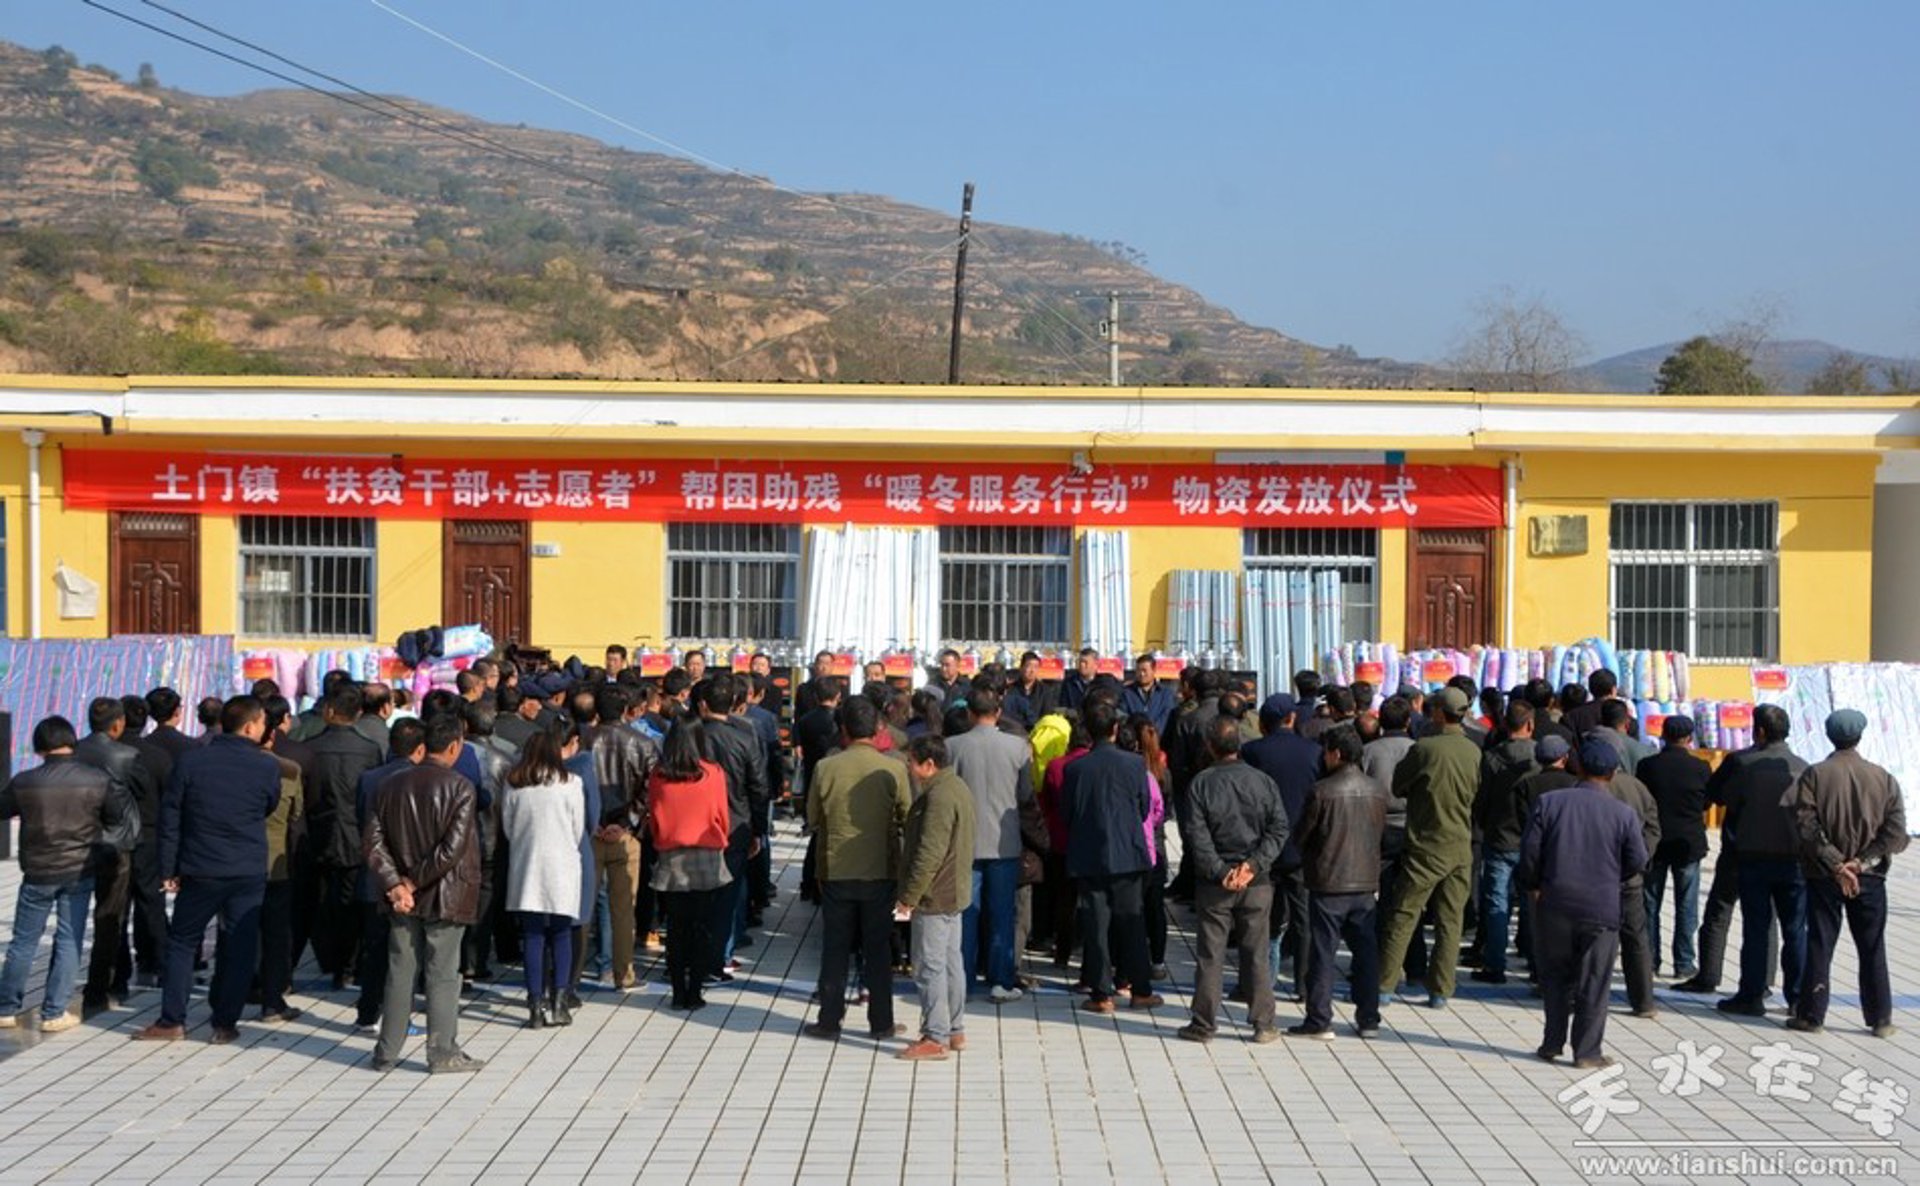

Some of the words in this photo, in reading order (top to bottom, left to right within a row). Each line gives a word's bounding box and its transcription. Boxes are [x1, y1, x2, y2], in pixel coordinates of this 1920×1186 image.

[152, 464, 280, 503] 土门镇
[1172, 476, 1418, 516] 物资发放仪式
